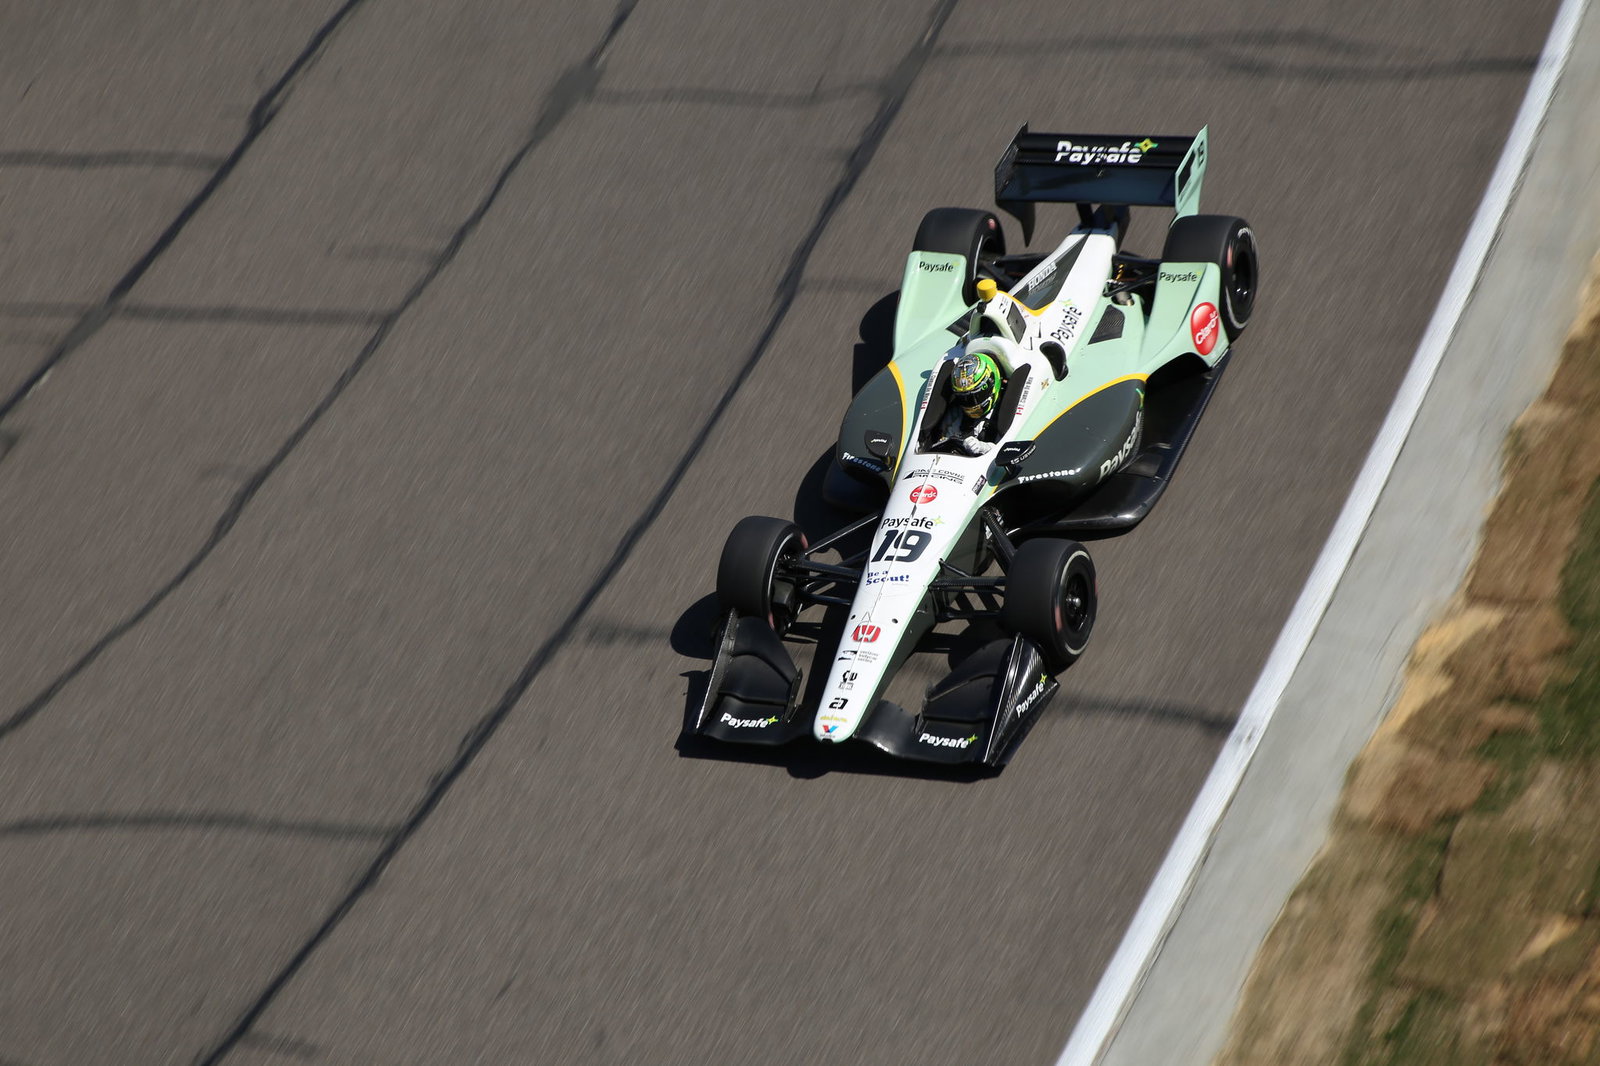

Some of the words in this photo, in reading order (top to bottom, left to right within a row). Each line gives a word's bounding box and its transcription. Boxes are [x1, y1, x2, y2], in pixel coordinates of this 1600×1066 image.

[1055, 141, 1142, 165] Paysafe
[919, 261, 954, 273] Paysafe
[1028, 261, 1057, 291] HONDA
[1160, 272, 1198, 283] Paysafe
[1050, 306, 1082, 346] Paysafe
[841, 452, 881, 472] Firestone
[1018, 470, 1075, 484] Firestone
[881, 517, 934, 529] Paysafe
[871, 529, 932, 563] 19
[1016, 682, 1045, 718] Paysafe
[720, 712, 769, 728] Paysafe
[919, 733, 969, 749] Paysafe
